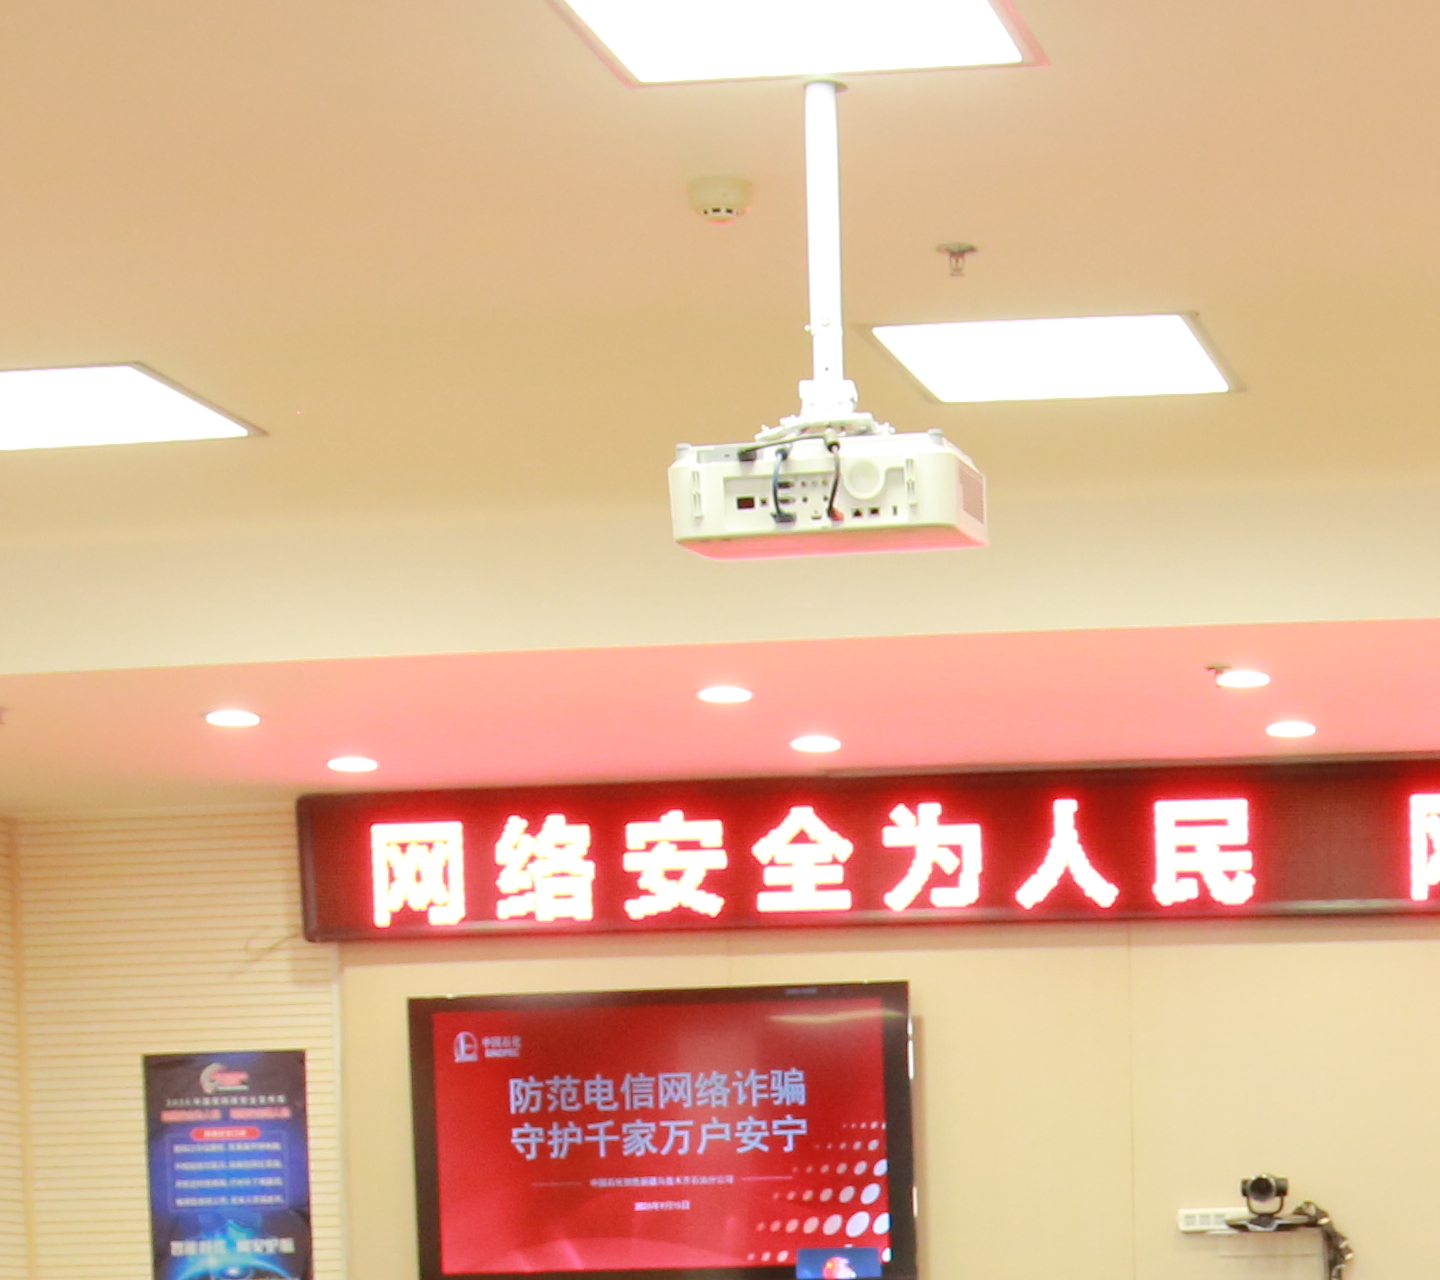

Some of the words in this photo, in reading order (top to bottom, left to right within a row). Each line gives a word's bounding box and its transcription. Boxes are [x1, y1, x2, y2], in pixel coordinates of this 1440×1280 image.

[370, 797, 1254, 927] 网络安全为人民
[509, 1069, 807, 1114] 防范电信网络诈骗
[511, 1116, 808, 1160] 守护千家万户安宁
